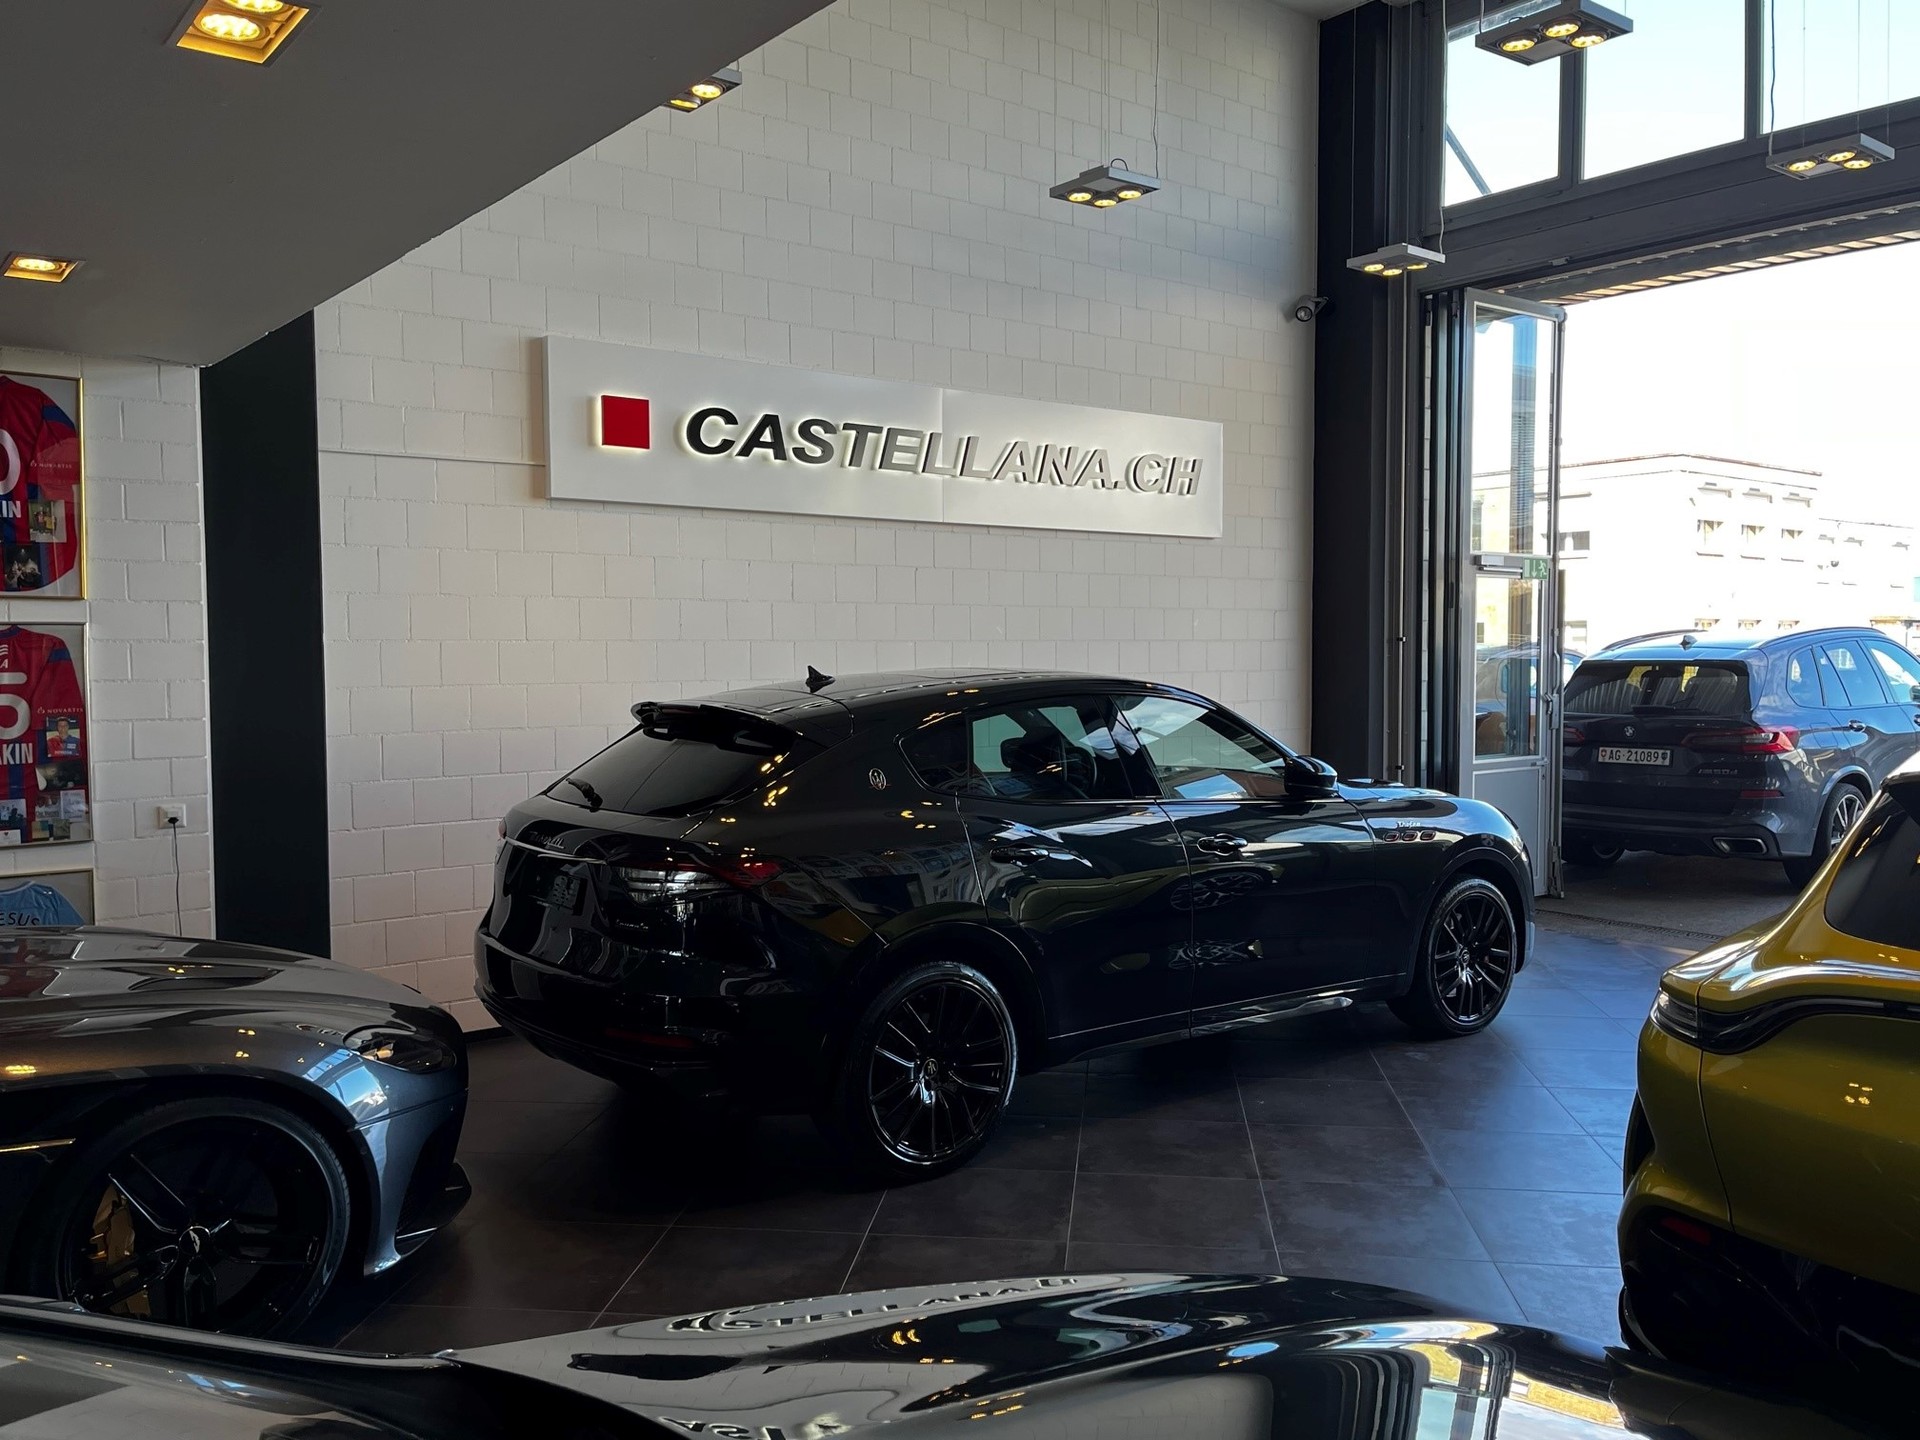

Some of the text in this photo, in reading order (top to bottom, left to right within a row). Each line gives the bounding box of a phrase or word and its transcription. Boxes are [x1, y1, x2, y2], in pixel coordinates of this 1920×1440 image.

[686, 407, 1204, 496] CASTELLANA.CH
[0, 500, 22, 518] IN
[0, 742, 34, 766] KIN
